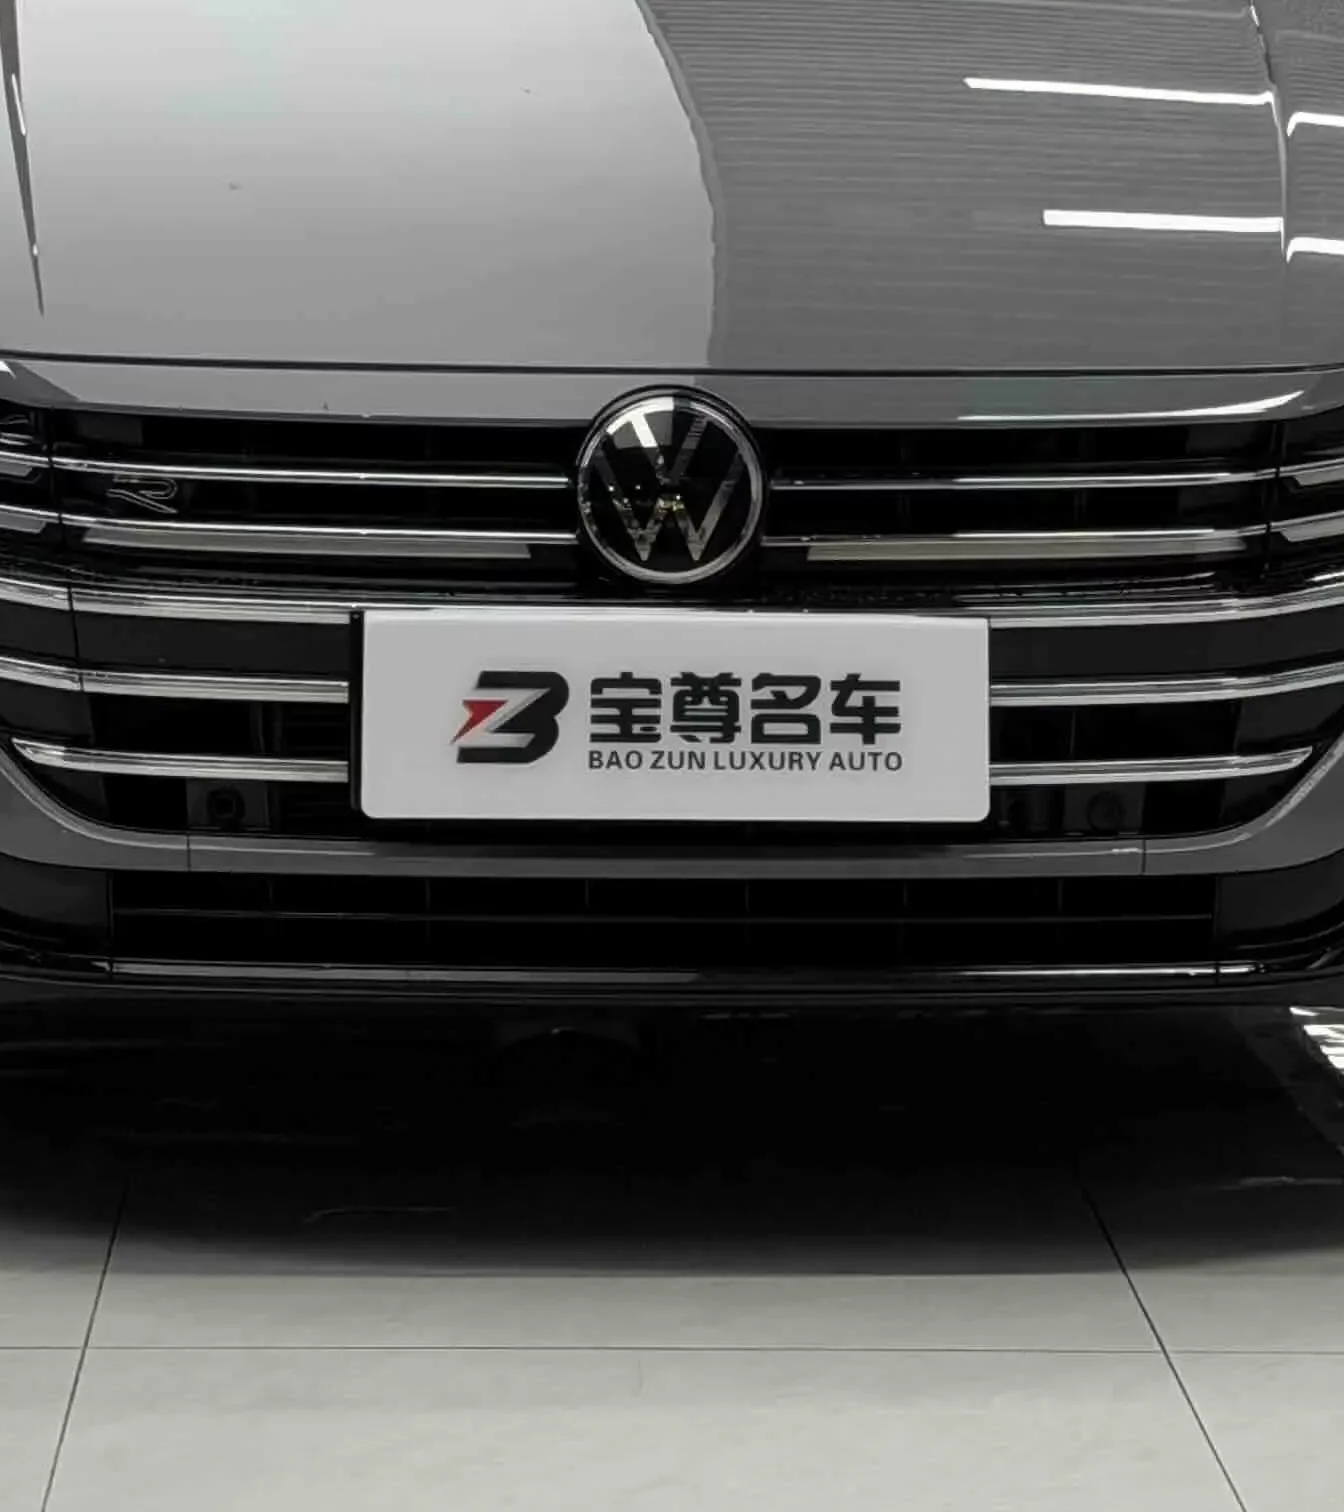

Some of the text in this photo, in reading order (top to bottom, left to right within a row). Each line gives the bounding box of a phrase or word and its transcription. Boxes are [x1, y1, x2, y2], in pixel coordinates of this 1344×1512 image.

[589, 671, 902, 745] 宝尊名车
[588, 749, 903, 771] BAO ZUN LUXURY AUTO
